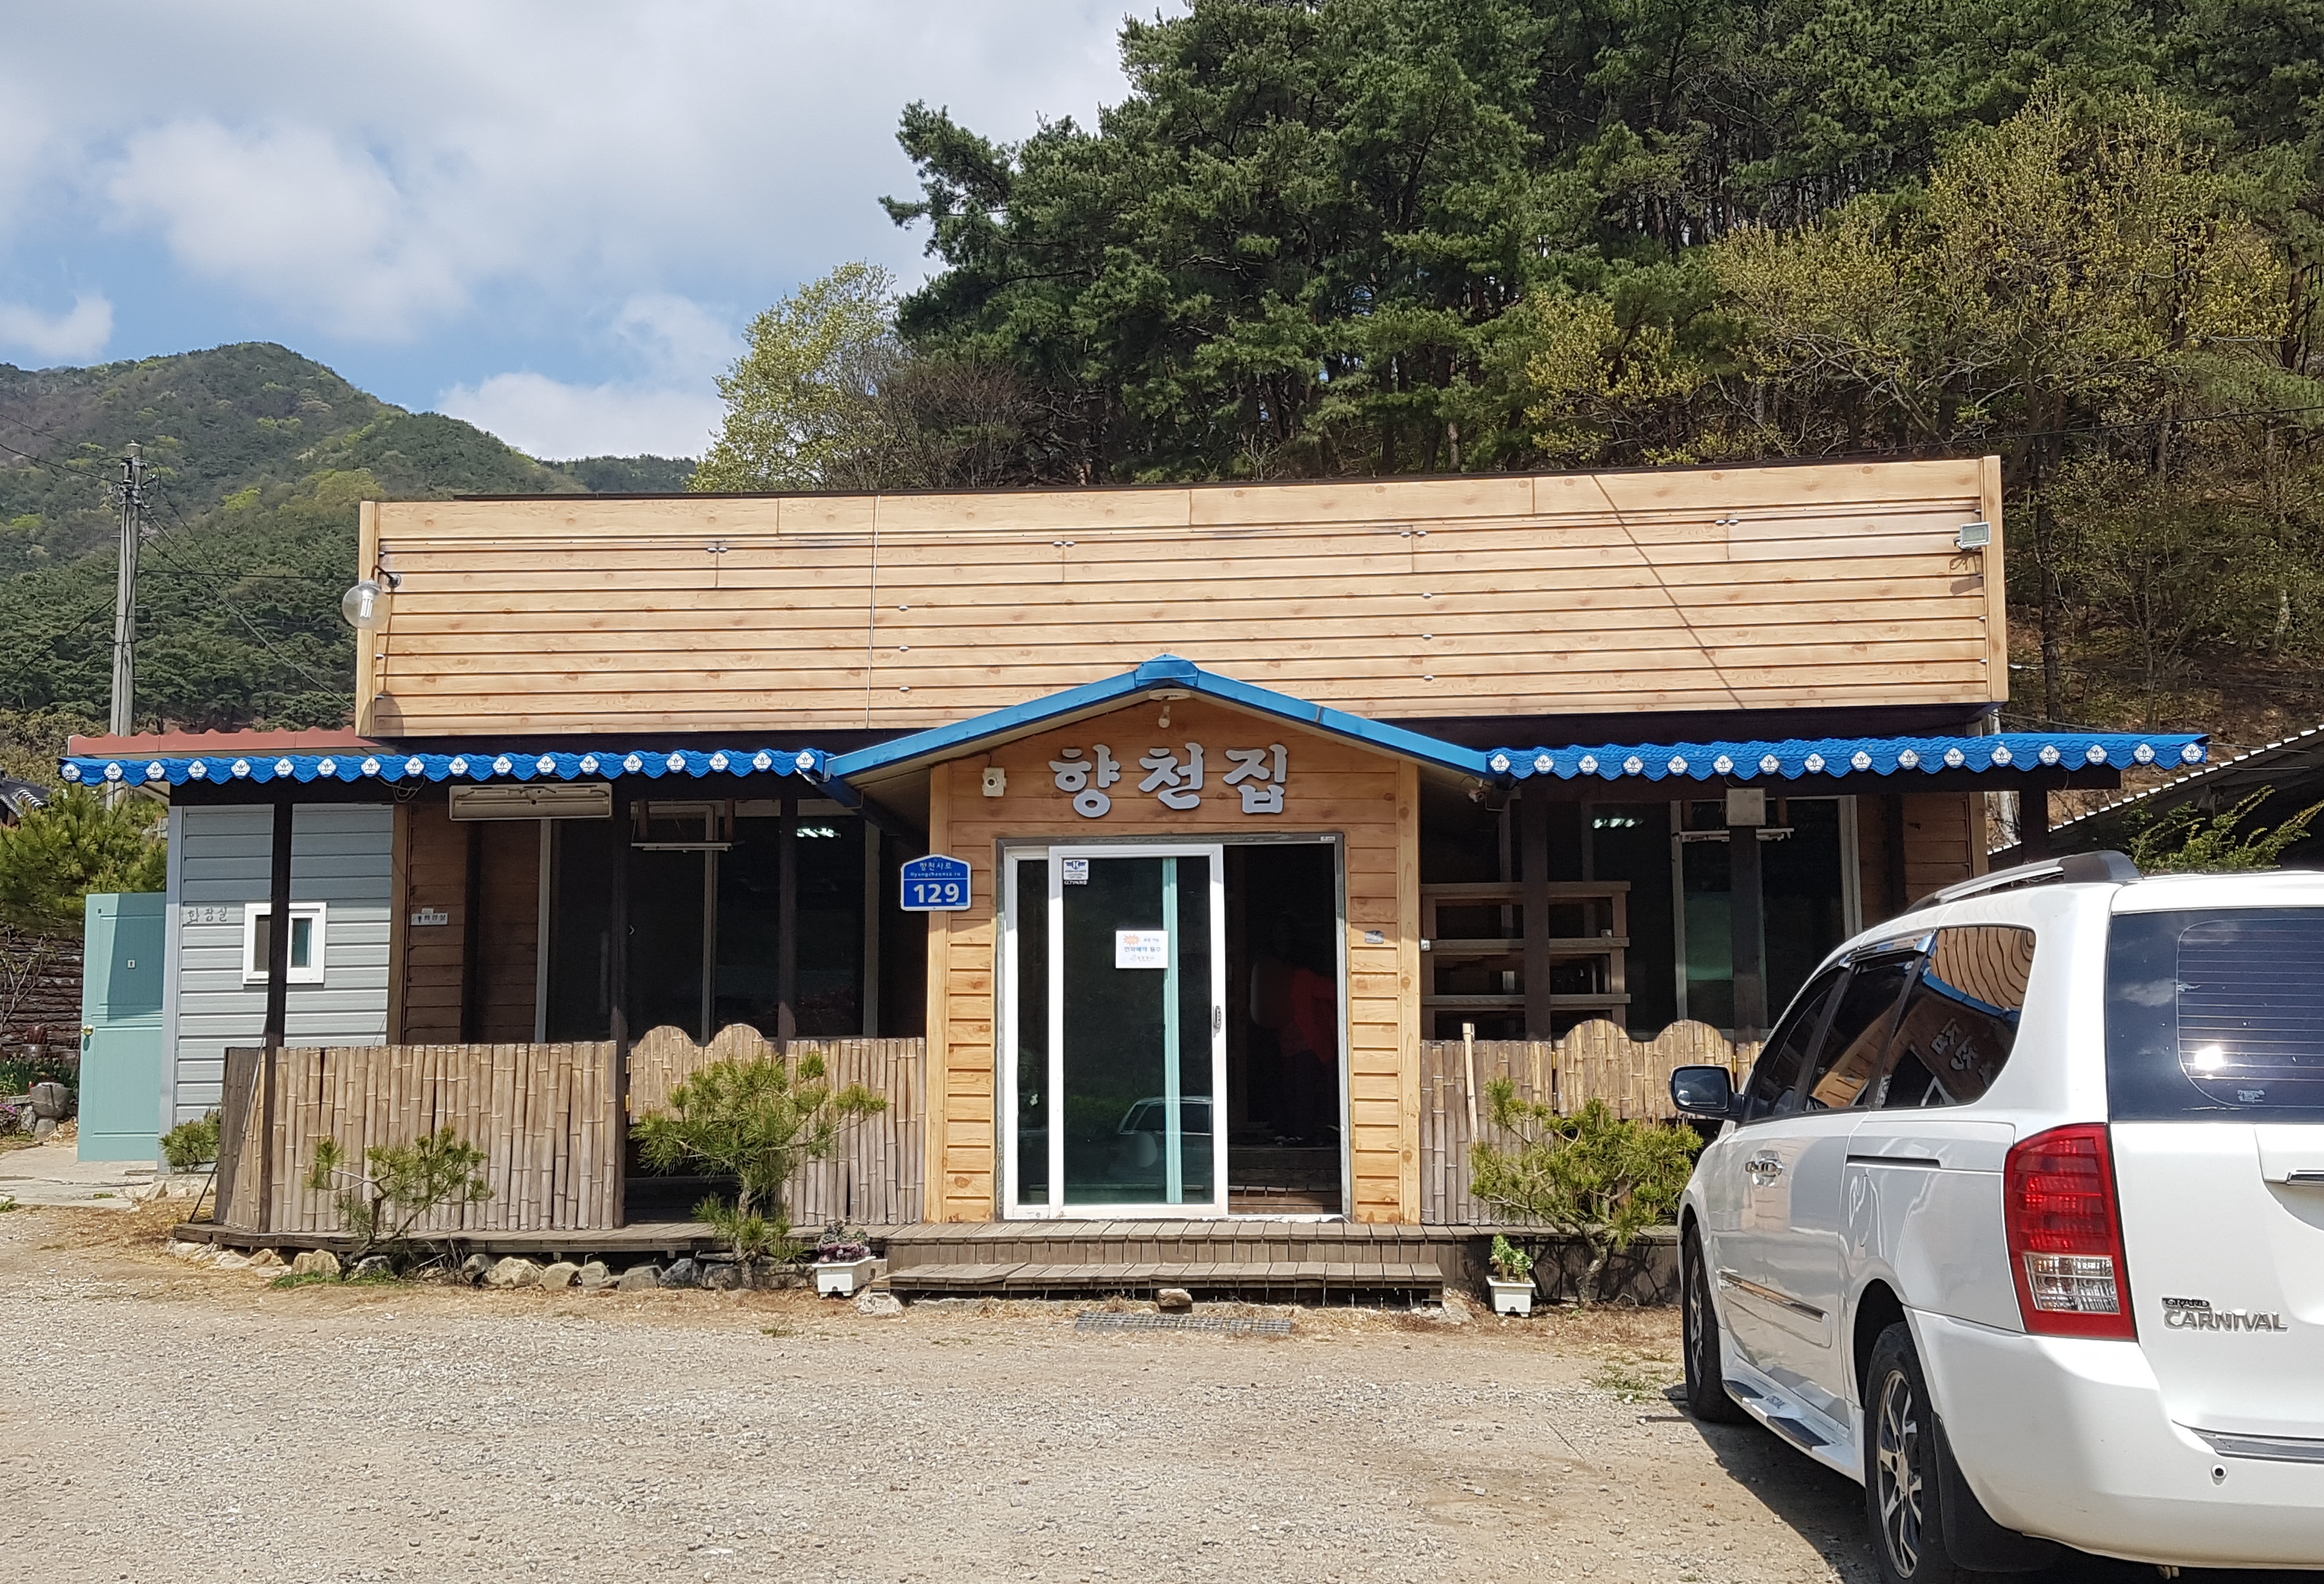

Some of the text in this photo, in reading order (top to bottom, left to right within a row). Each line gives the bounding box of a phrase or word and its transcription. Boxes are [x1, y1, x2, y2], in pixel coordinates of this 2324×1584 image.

[1048, 742, 1288, 818] 향천집
[913, 883, 959, 903] 129
[186, 906, 227, 924] 화장실
[2165, 1298, 2210, 1308] GRAND
[2164, 1308, 2289, 1332] CARNIVAL
